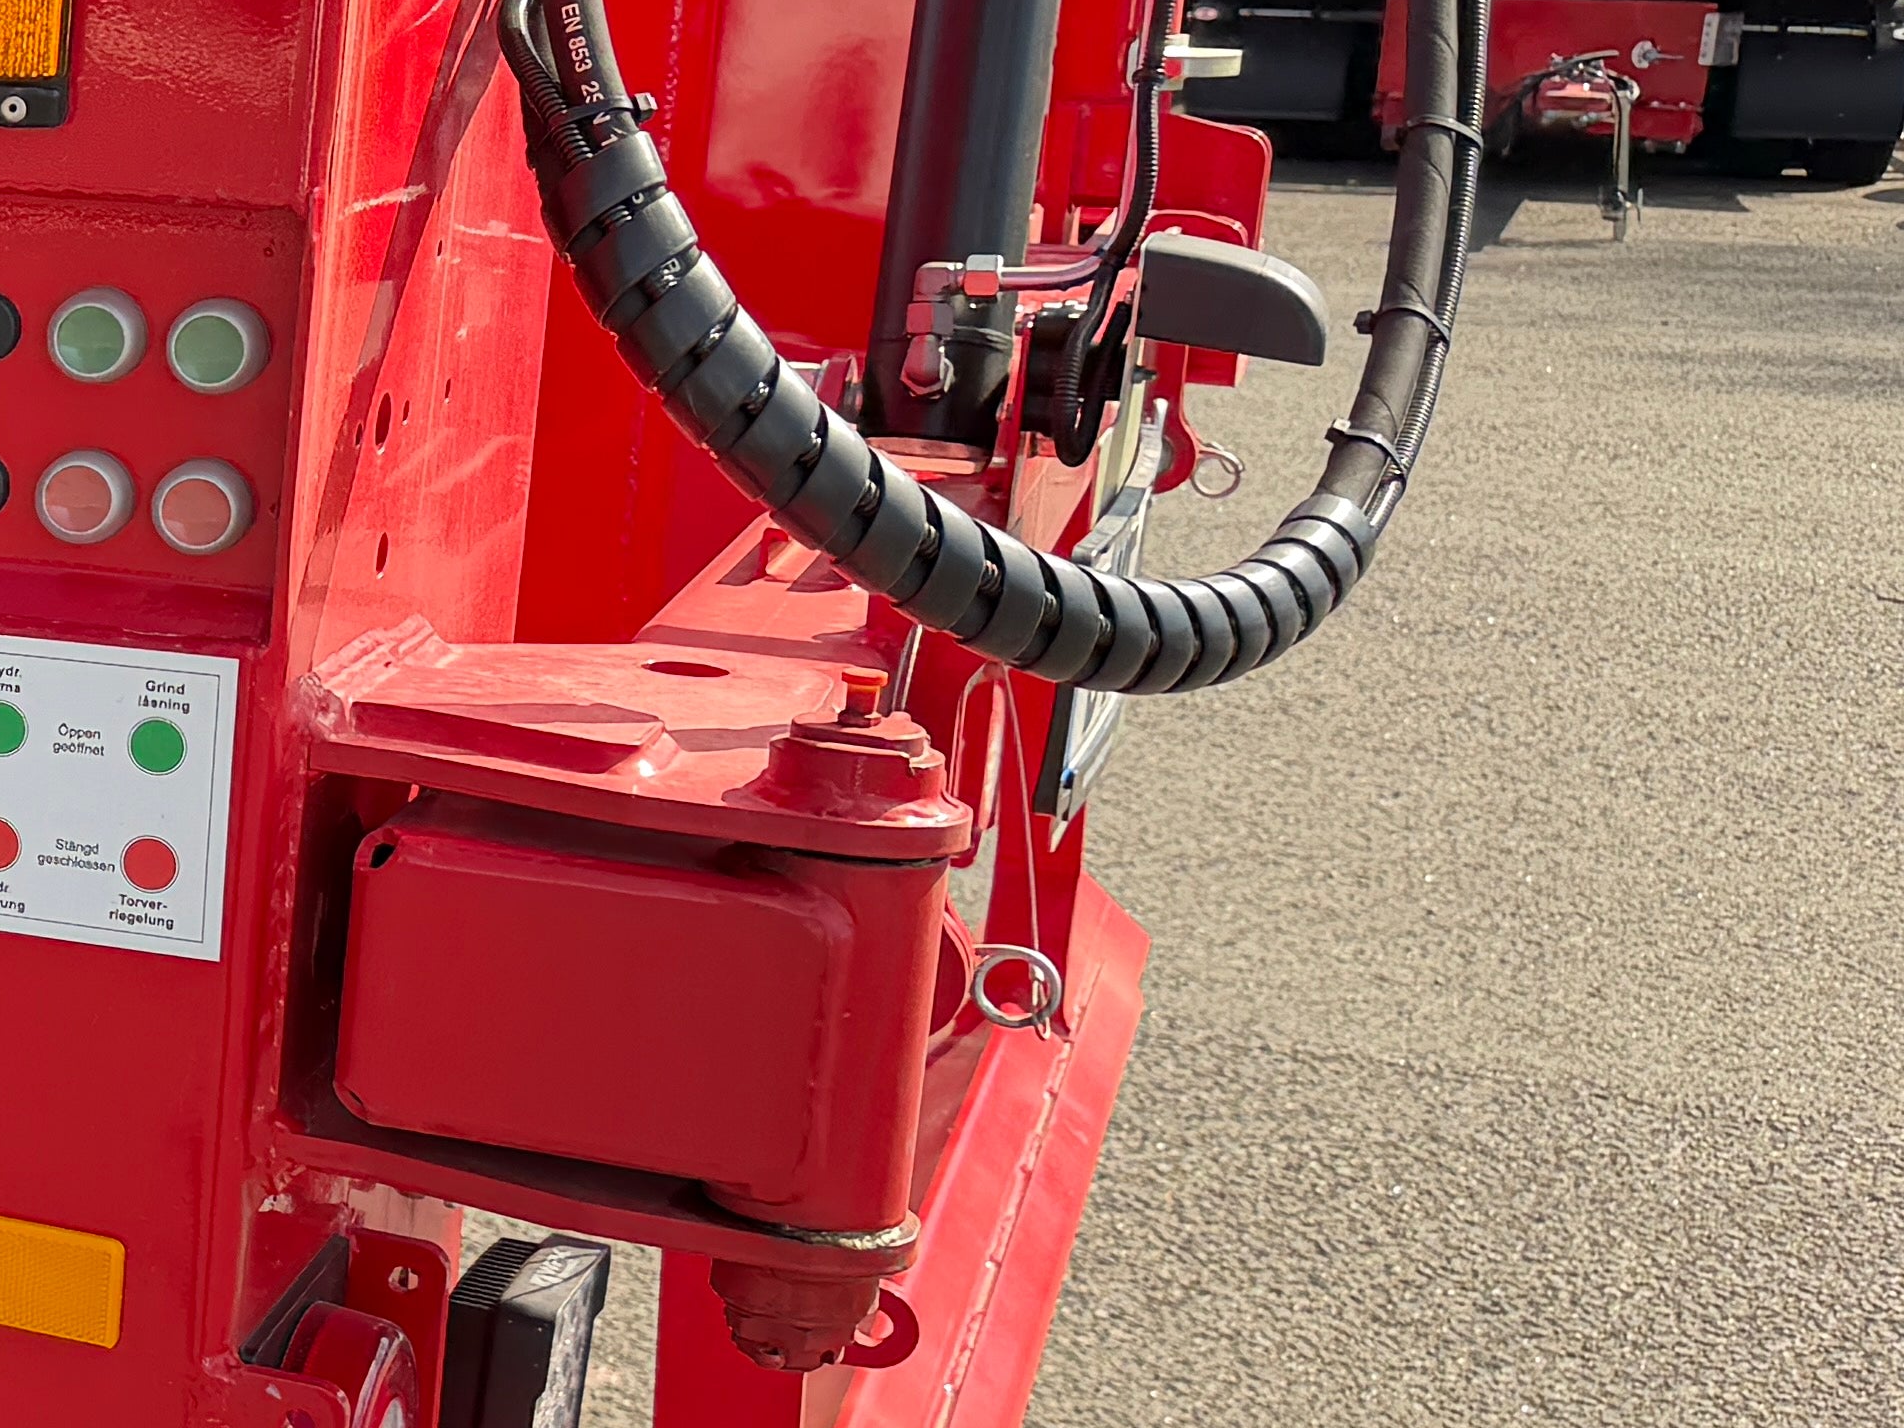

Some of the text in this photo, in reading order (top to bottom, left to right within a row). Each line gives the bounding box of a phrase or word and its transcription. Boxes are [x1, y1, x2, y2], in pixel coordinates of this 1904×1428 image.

[561, 3, 584, 33] EN
[568, 36, 593, 73] 853
[145, 679, 186, 695] Grind
[138, 695, 191, 714] låsning
[52, 741, 105, 757] geöffnet
[55, 838, 100, 856] Stängd
[37, 853, 116, 873] geschlossen
[118, 893, 169, 911] Torver-
[108, 910, 175, 931] riegelung
